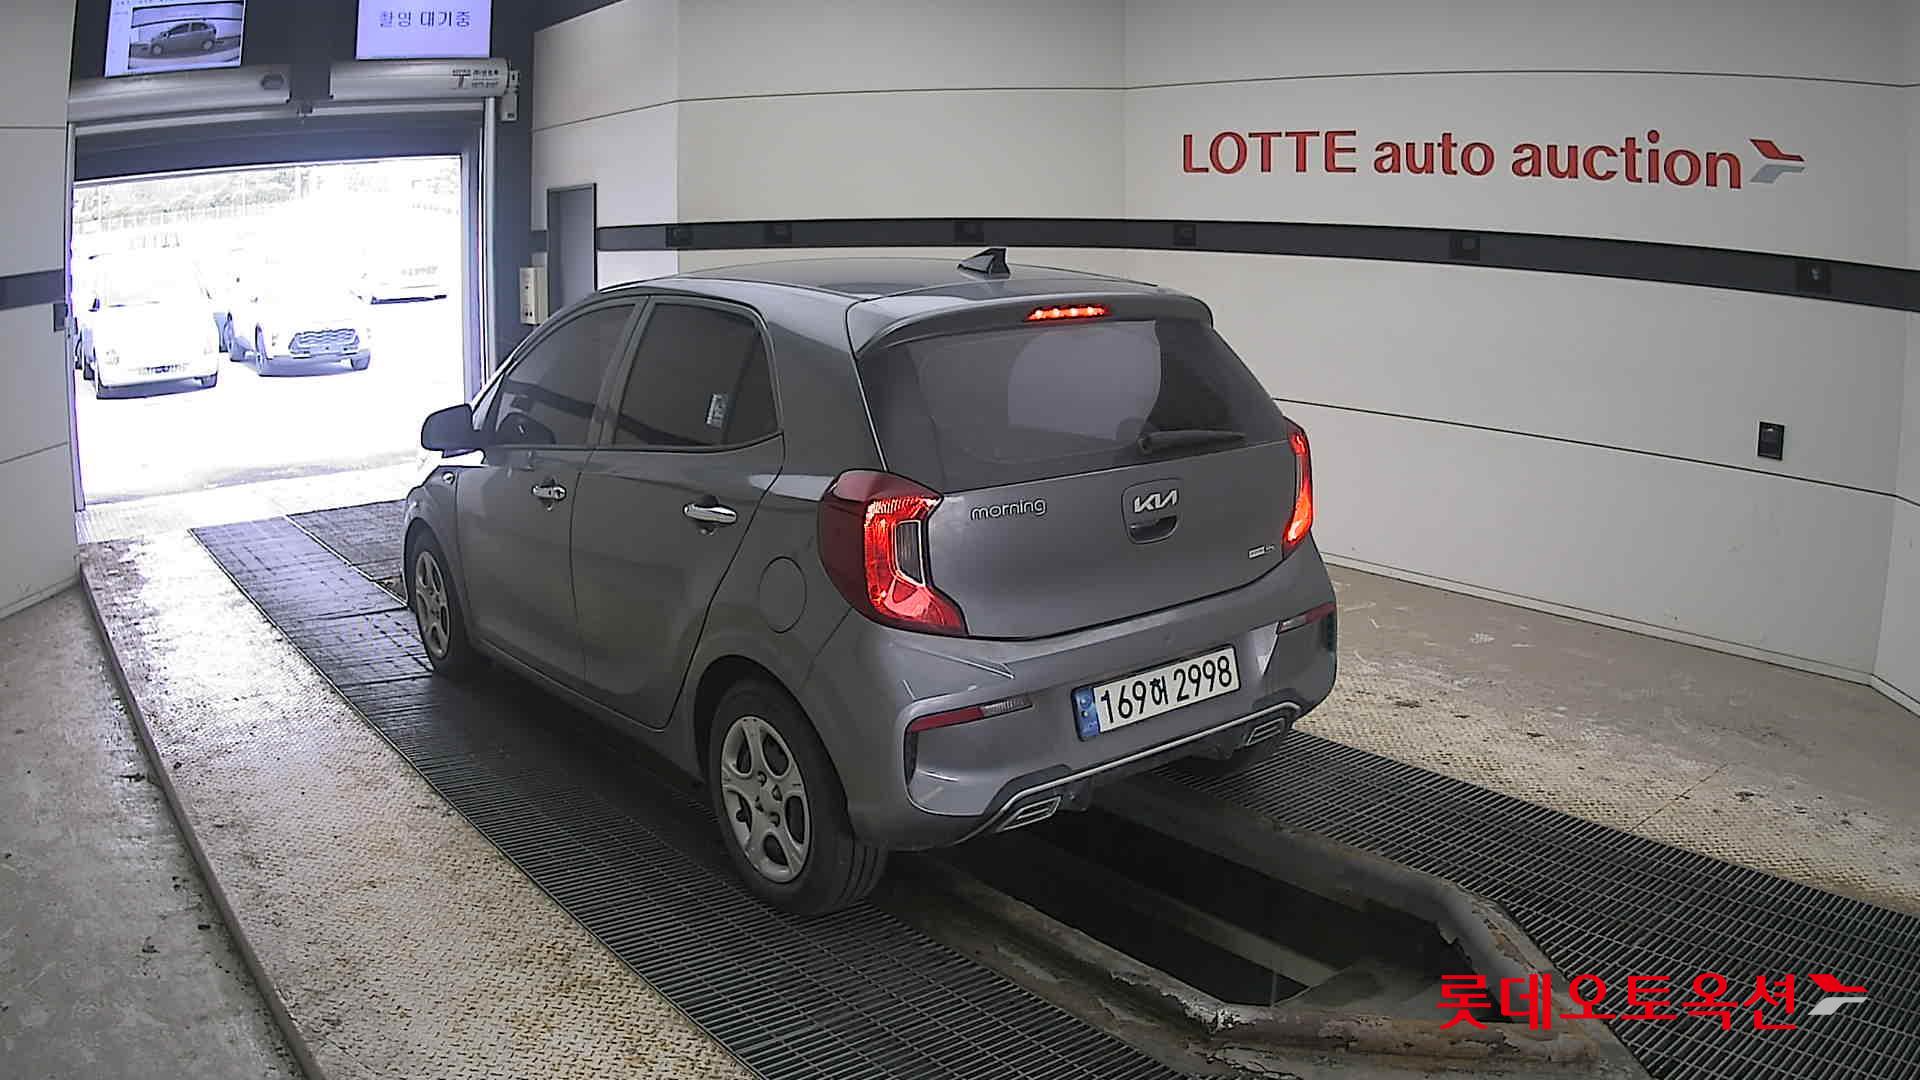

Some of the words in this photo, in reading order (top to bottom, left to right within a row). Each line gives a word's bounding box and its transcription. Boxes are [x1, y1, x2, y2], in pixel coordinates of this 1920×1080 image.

[420, 10, 472, 28] 대기중
[1182, 129, 1358, 174] LOTTE
[1373, 131, 1496, 177] auto
[1511, 129, 1743, 190] auction
[969, 497, 1048, 521] morning
[1100, 675, 1170, 724] 169허
[1173, 655, 1233, 701] 2998
